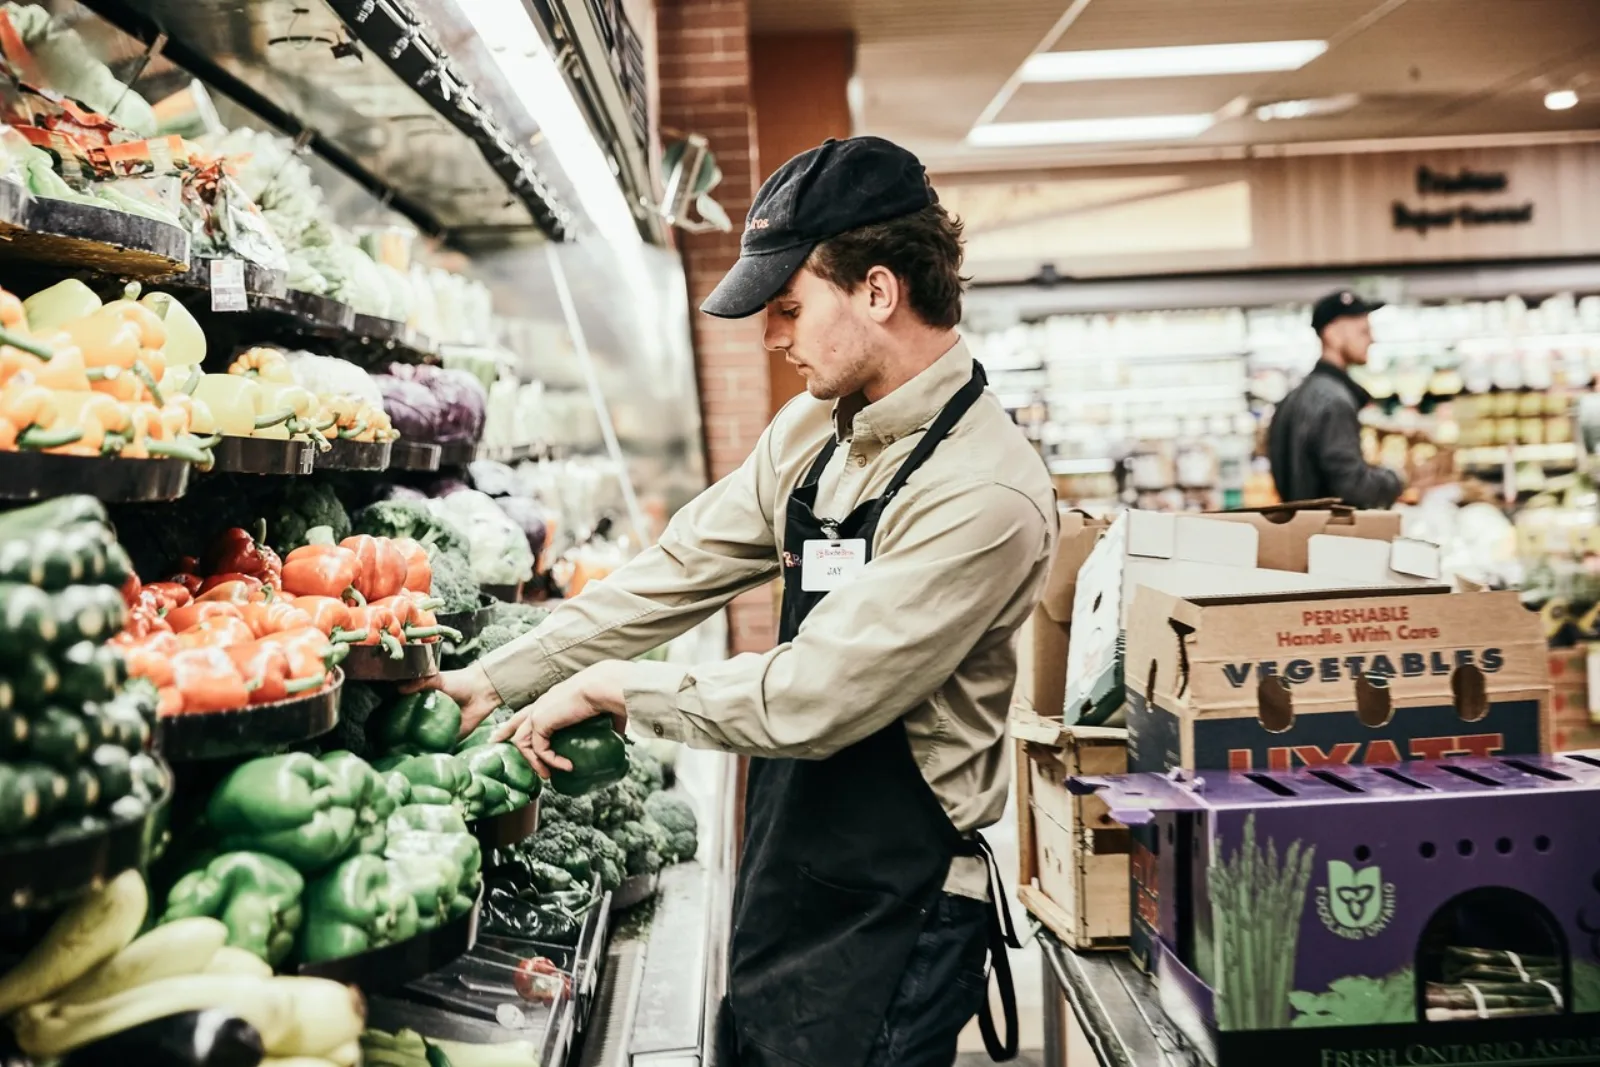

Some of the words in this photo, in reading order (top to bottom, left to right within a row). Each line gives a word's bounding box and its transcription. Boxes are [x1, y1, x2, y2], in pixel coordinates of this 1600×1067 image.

[827, 566, 843, 576] JAY
[1302, 606, 1410, 627] PERISHABLE
[1277, 629, 1343, 648] Handle
[1347, 625, 1392, 643] With
[1396, 625, 1441, 642] Care
[1221, 648, 1504, 688] VEGETABLES
[1365, 882, 1396, 937] ONTARIO
[1320, 1047, 1397, 1067] FRESH
[1404, 1042, 1523, 1066] ONTARIO
